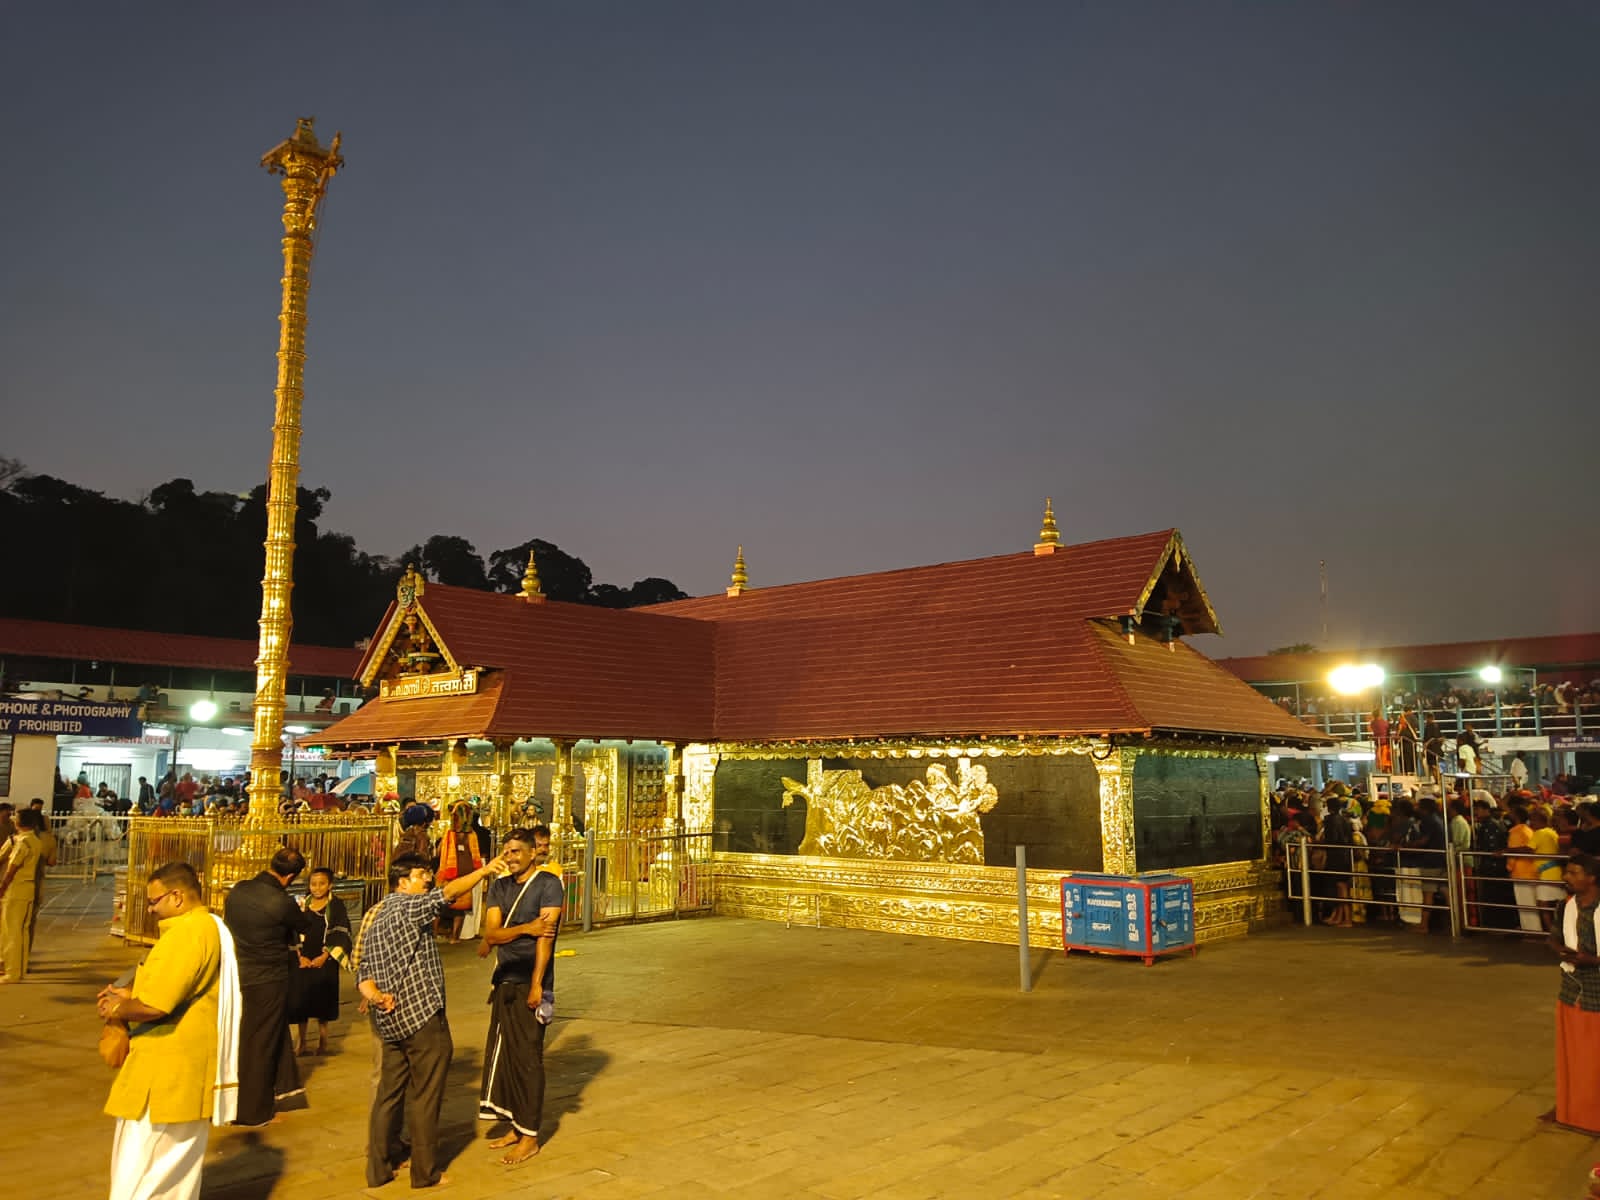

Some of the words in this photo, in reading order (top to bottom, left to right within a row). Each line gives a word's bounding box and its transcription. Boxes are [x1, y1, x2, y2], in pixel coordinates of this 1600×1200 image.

[0, 702, 38, 714] PHONE
[41, 703, 51, 716] &
[53, 704, 131, 718] PHOTOGRAPHY
[19, 719, 83, 732] PROHIBITED
